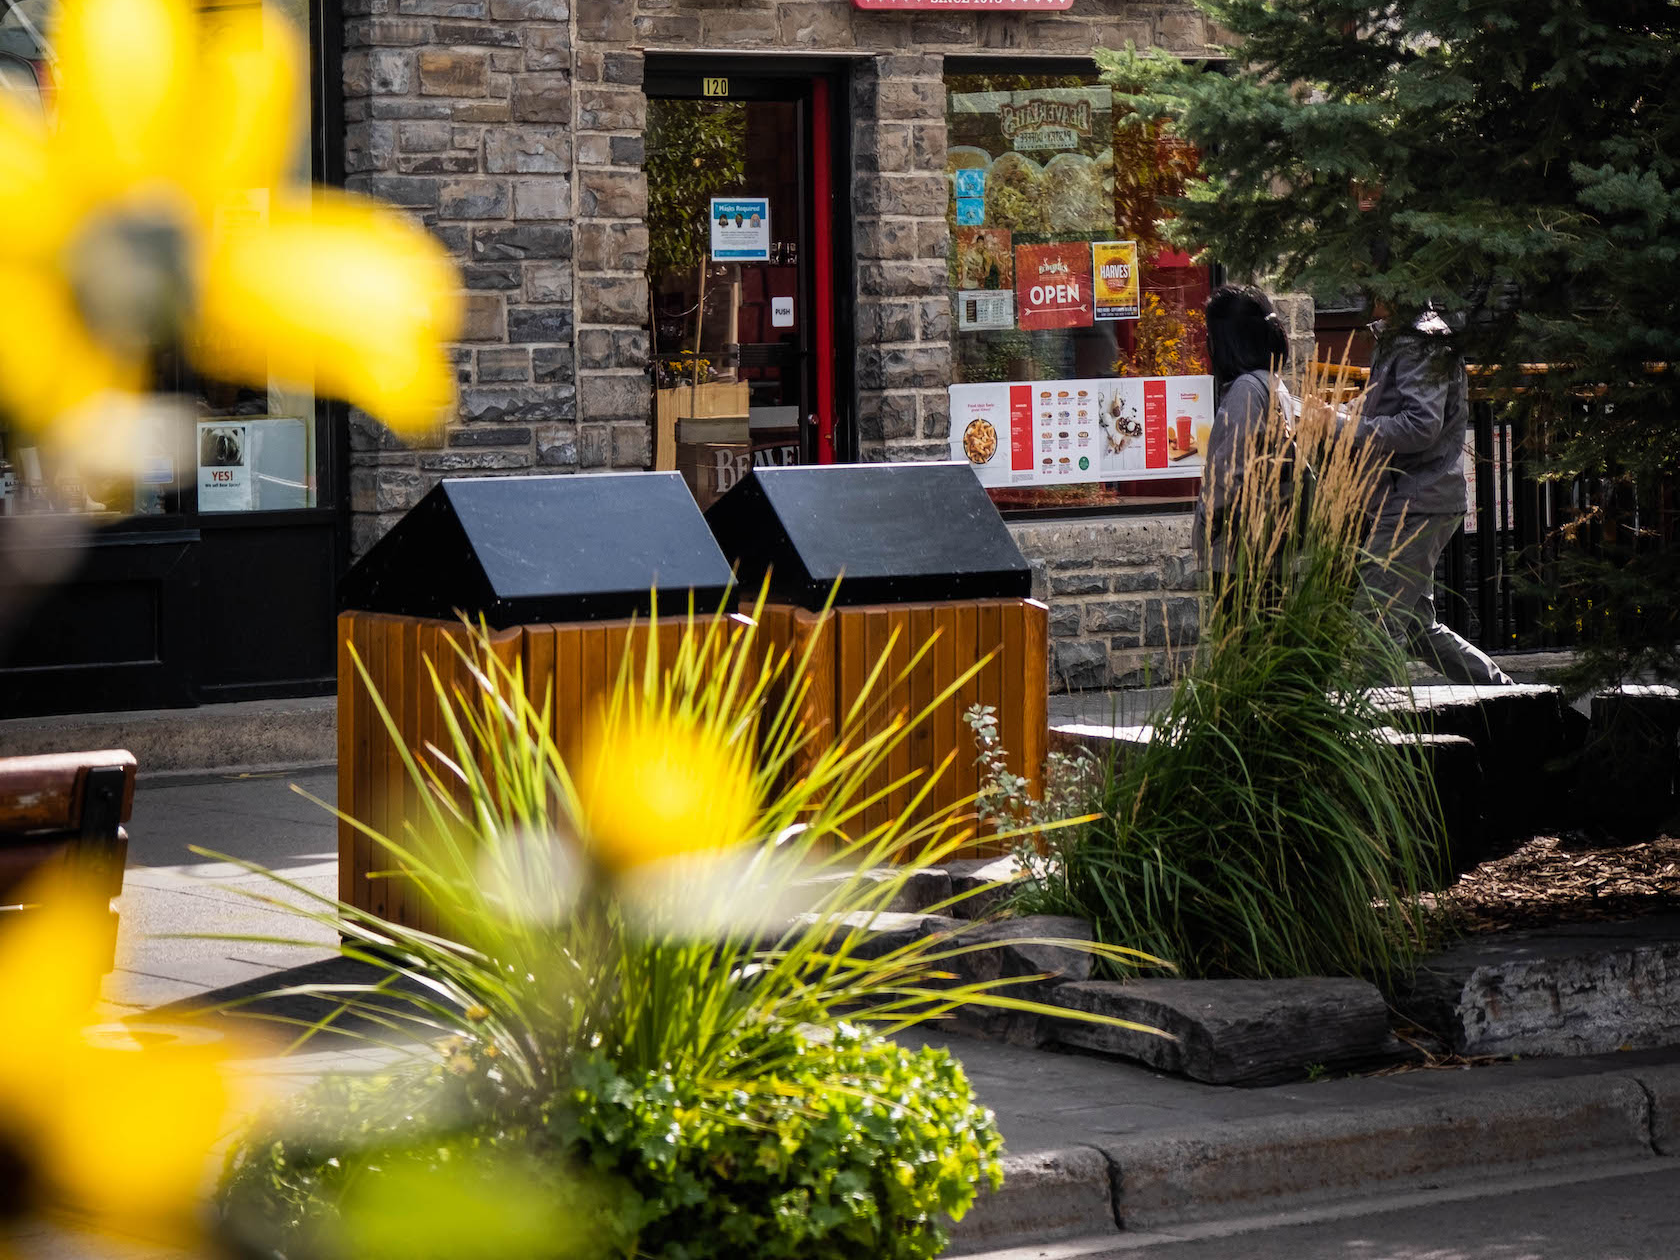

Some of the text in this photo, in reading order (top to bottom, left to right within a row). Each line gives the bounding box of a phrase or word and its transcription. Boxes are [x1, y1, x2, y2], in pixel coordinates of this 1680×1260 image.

[706, 79, 727, 95] 120
[718, 204, 760, 213] Masks Required
[1100, 264, 1131, 279] HARVEST
[1029, 283, 1080, 305] OPEN
[211, 470, 233, 481] YES!
[715, 445, 800, 493] BEAVE
